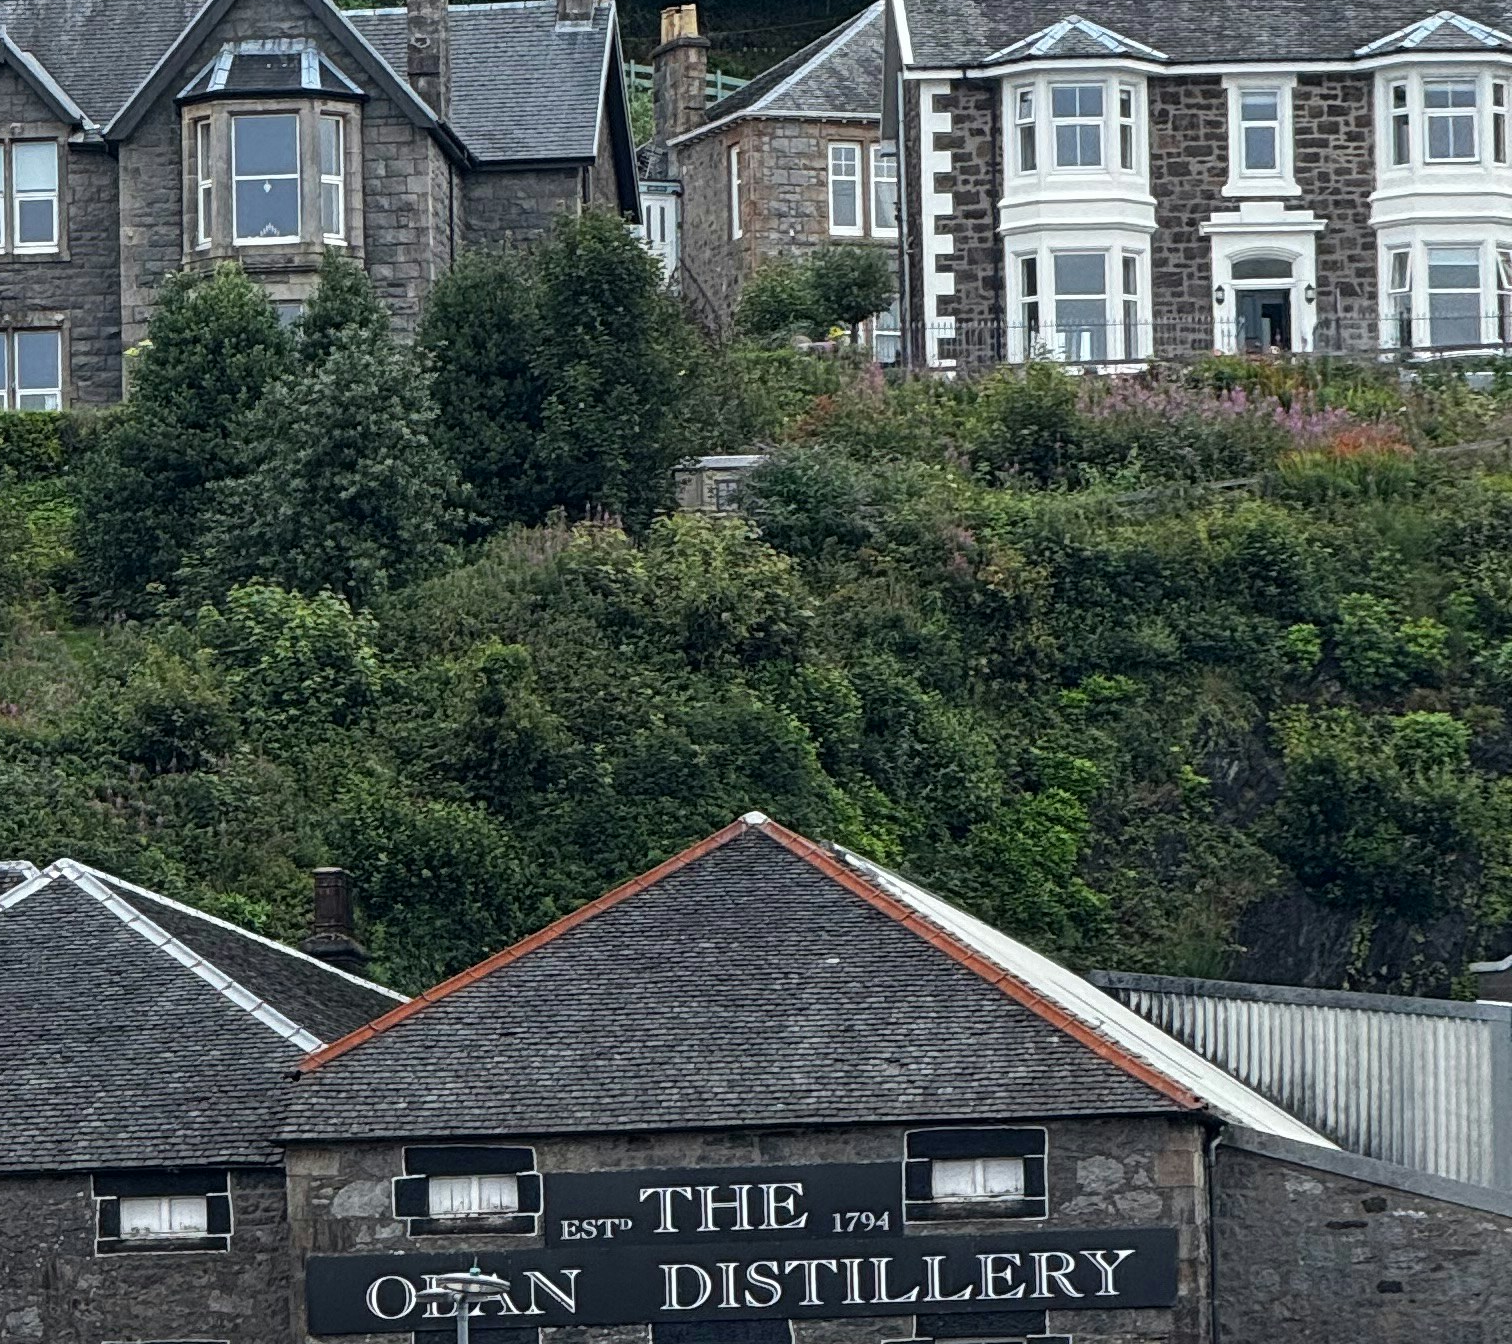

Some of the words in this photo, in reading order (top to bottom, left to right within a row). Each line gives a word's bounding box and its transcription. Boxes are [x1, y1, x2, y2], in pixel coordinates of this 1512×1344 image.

[639, 1182, 809, 1234] THE
[831, 1211, 890, 1233] 1794
[658, 1249, 1136, 1311] DISTILLERY
